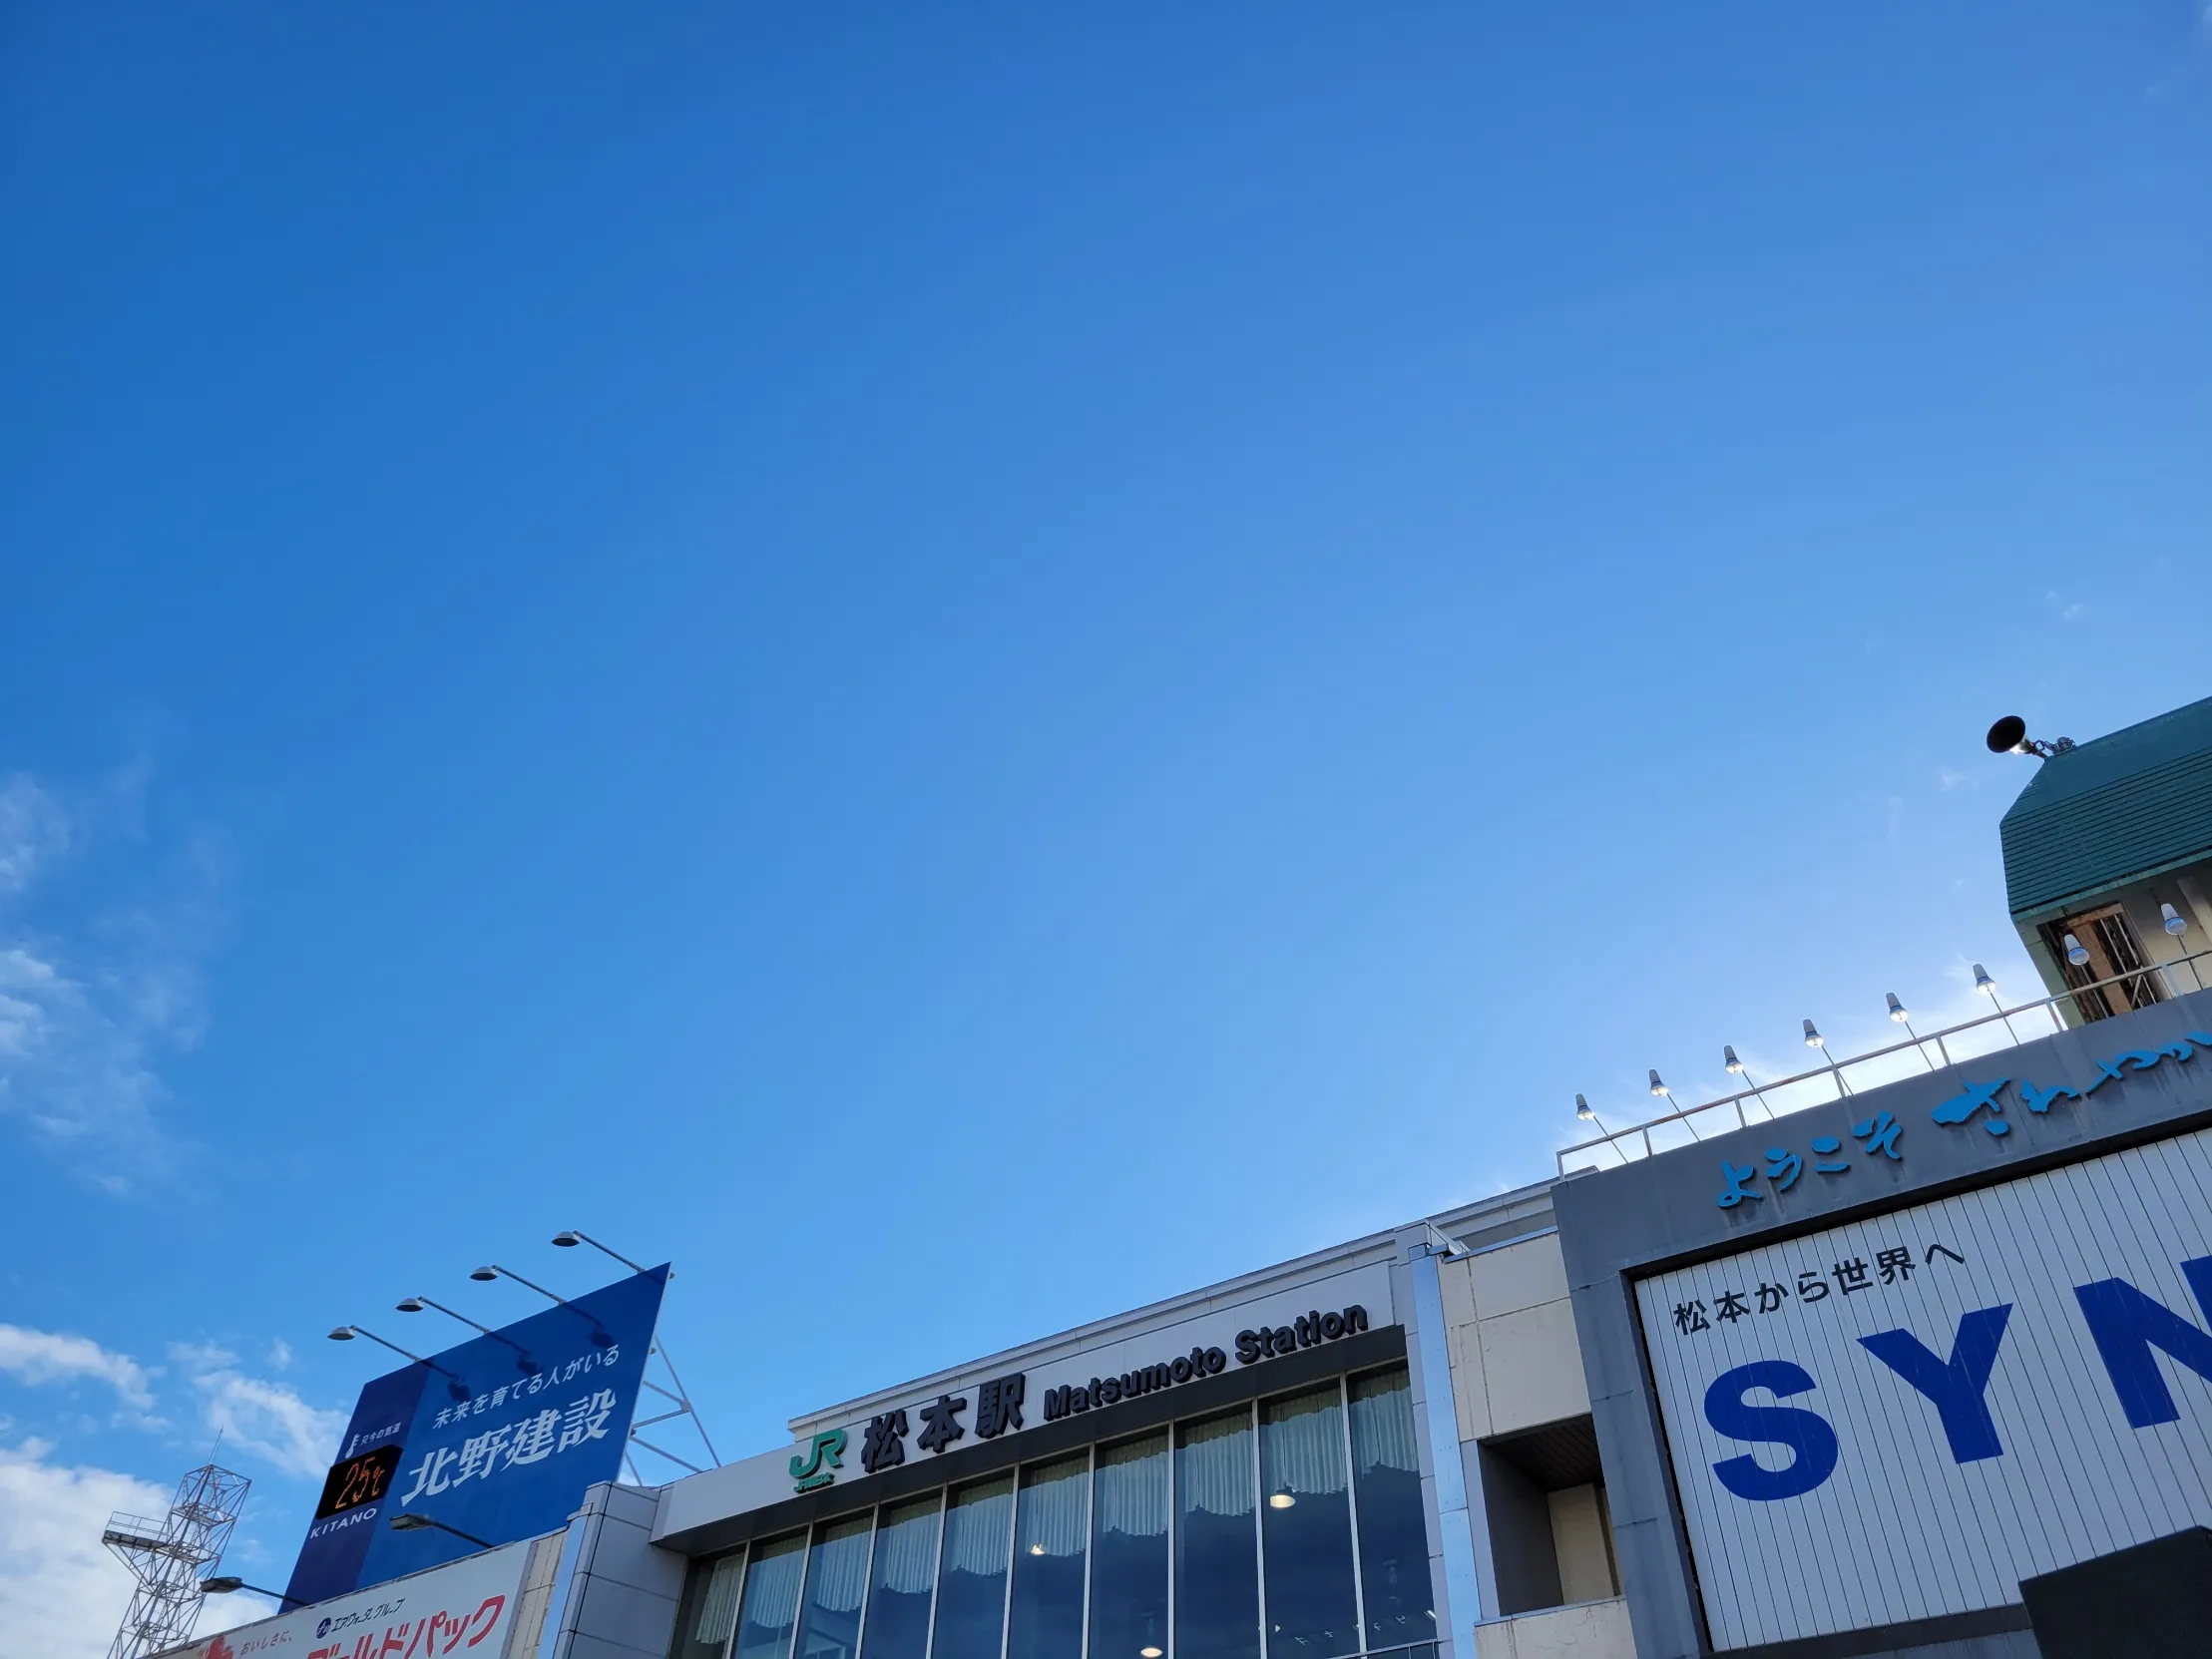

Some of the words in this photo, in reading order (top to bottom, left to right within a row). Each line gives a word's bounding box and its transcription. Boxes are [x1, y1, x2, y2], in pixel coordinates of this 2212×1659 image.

[1717, 1110, 1903, 1209] ようこそ
[1674, 1242, 1965, 1336] 松本から世界へ
[432, 1344, 620, 1430] 未来を育てる人がいる
[1044, 1346, 1227, 1422] Matsumoto
[1234, 1304, 1369, 1365] Station
[1703, 1254, 2212, 1501] SYN
[401, 1388, 617, 1507] 北野建設
[789, 1429, 848, 1479] JR
[860, 1372, 1026, 1473] 松本駅
[310, 1508, 377, 1538] KITANO
[307, 1595, 505, 1659] ルドパック
